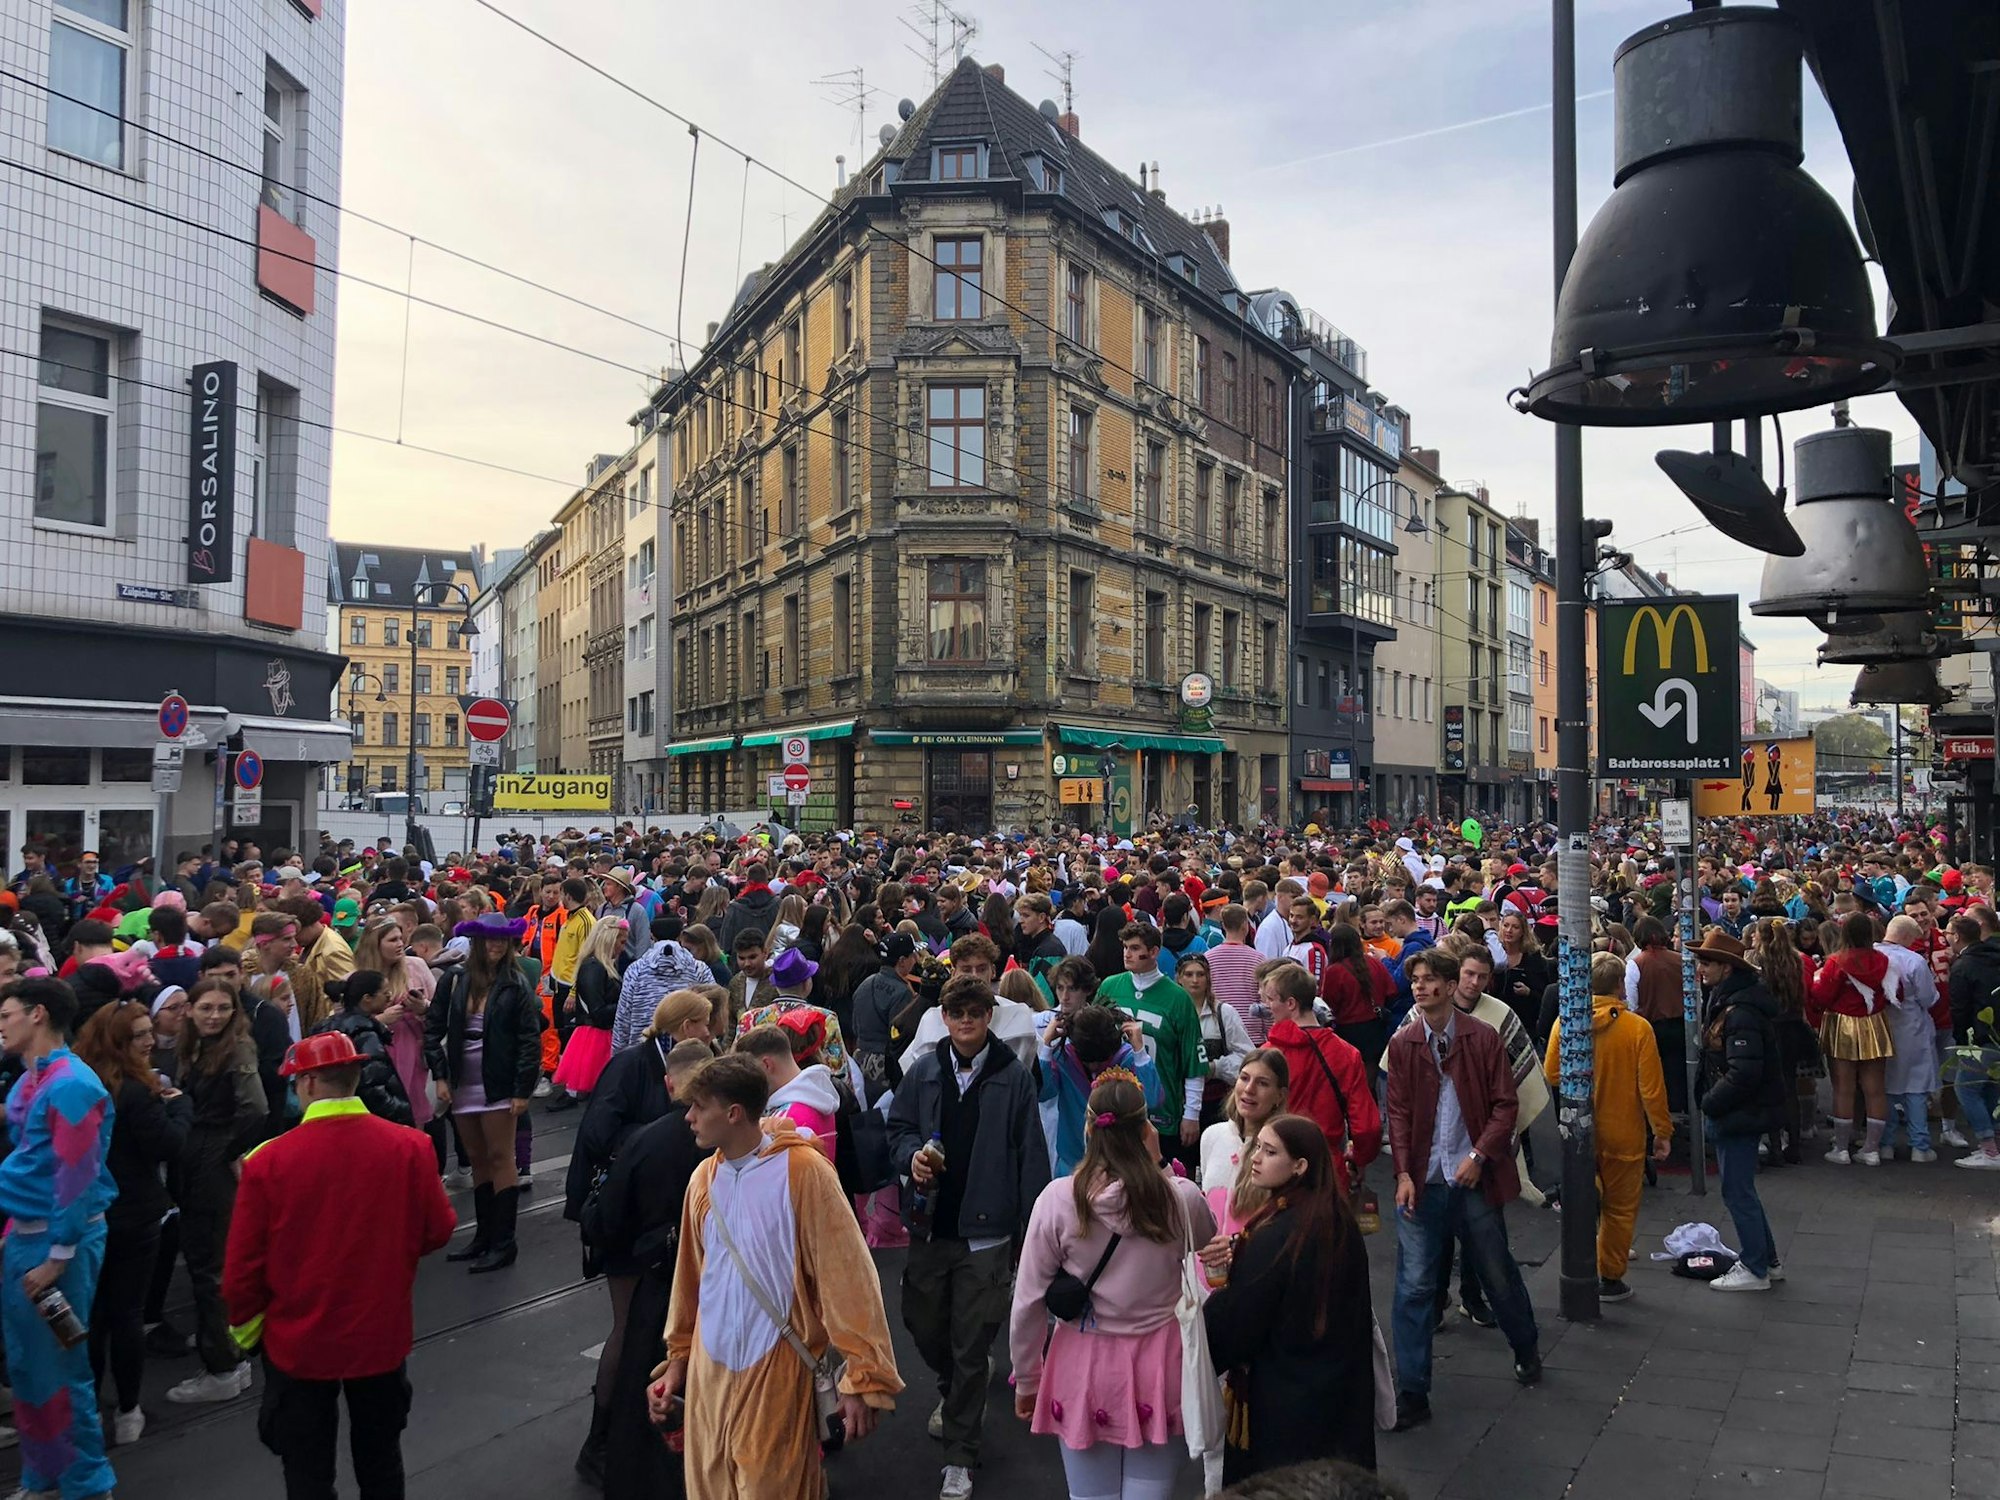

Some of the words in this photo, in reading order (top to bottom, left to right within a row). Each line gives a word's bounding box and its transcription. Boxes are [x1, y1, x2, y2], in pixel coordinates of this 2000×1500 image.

[192, 371, 220, 575] BORSALINO
[122, 586, 157, 599] Zülpicher
[791, 743, 802, 753] 30
[1950, 742, 1980, 755] früh
[1608, 757, 1721, 770] Barbarossaplatz
[1722, 757, 1730, 769] 1
